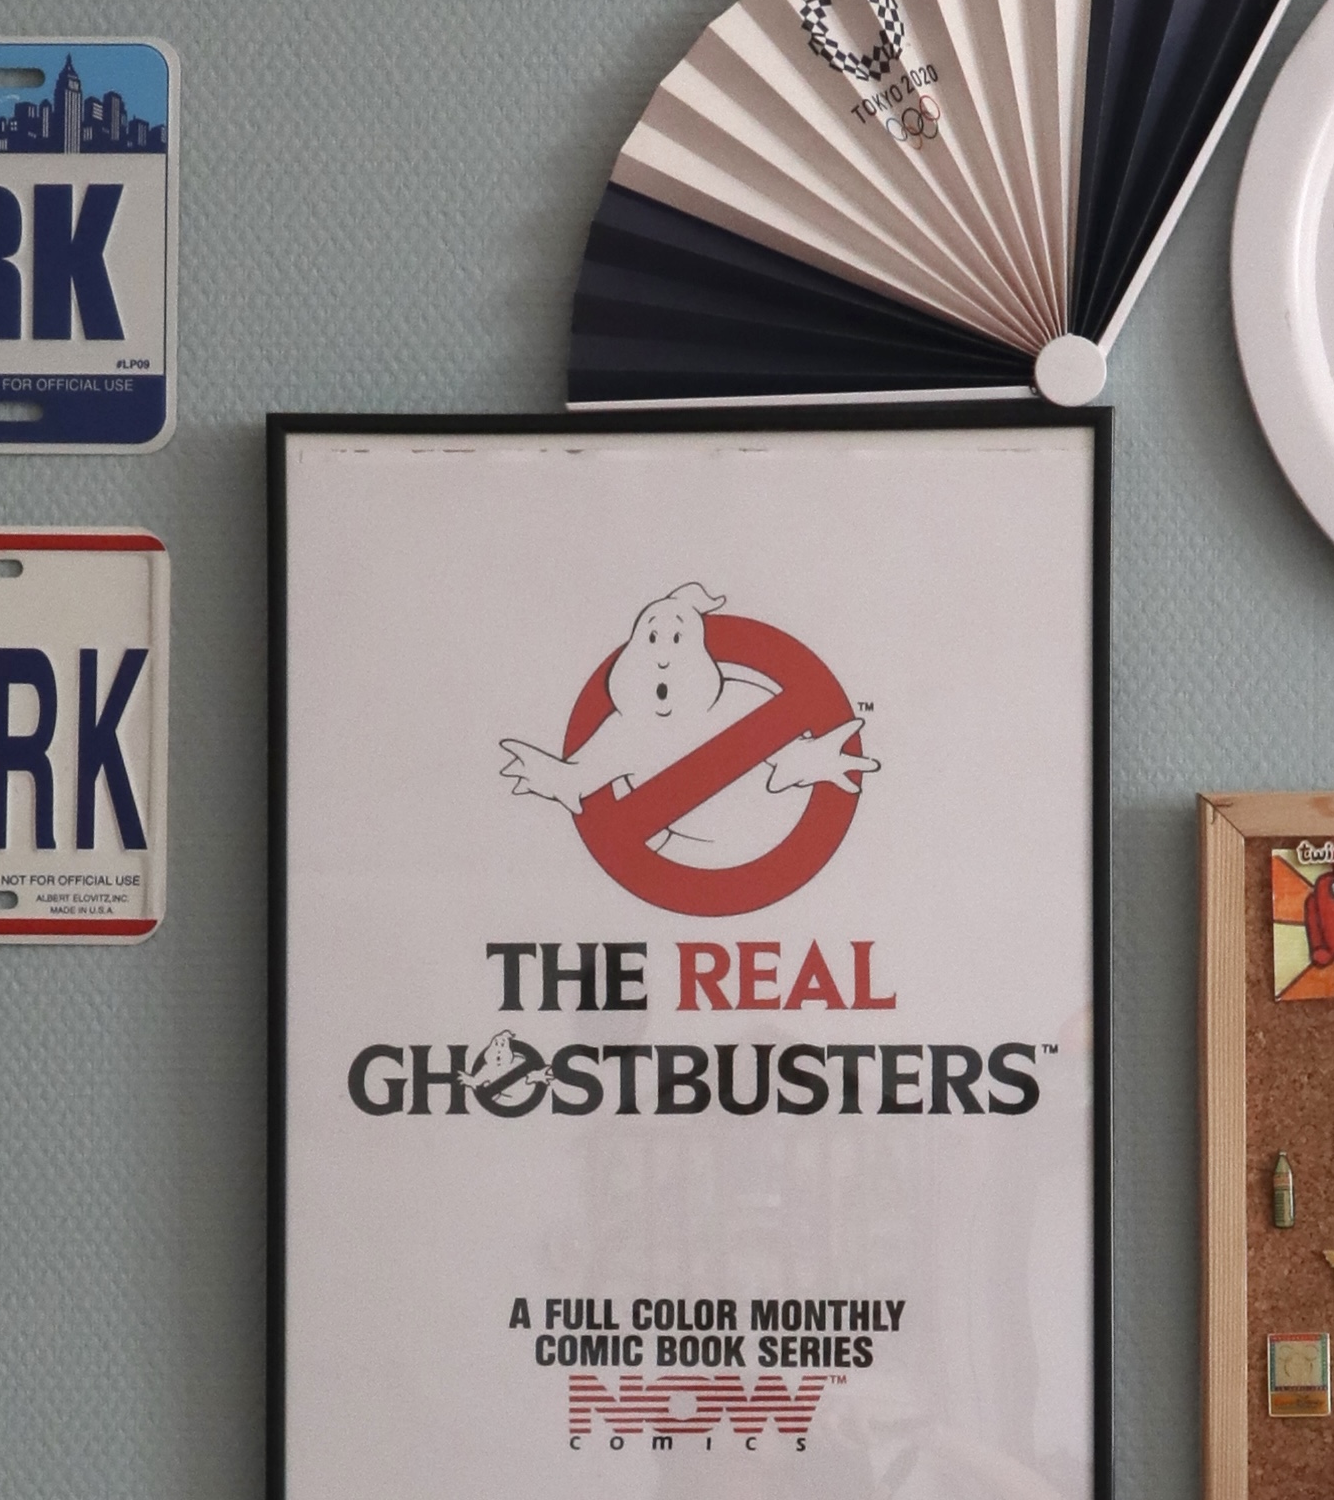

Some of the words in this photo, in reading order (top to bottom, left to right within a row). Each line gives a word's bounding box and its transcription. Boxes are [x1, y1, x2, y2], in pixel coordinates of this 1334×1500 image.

[851, 83, 904, 124] TOKYO
[900, 64, 938, 93] 2020
[2, 378, 32, 391] FOR
[36, 378, 101, 391] OFFICIAL
[104, 379, 134, 392] USE
[1, 875, 26, 886] NOT
[30, 875, 55, 886] FOR
[58, 875, 112, 886] OFFICIAL
[115, 876, 140, 886] USE
[487, 942, 648, 1011] THE
[676, 939, 897, 1012] REAL
[348, 1035, 1041, 1118] GHOSTBUSTERS
[509, 1298, 531, 1329] A
[545, 1298, 620, 1331] FULL
[632, 1299, 738, 1331] COLOR
[751, 1299, 906, 1332] MONTHLY
[535, 1335, 644, 1367] COMIC
[656, 1336, 746, 1367] BOOK
[758, 1336, 874, 1368] SERIES
[569, 1374, 828, 1434] NOW
